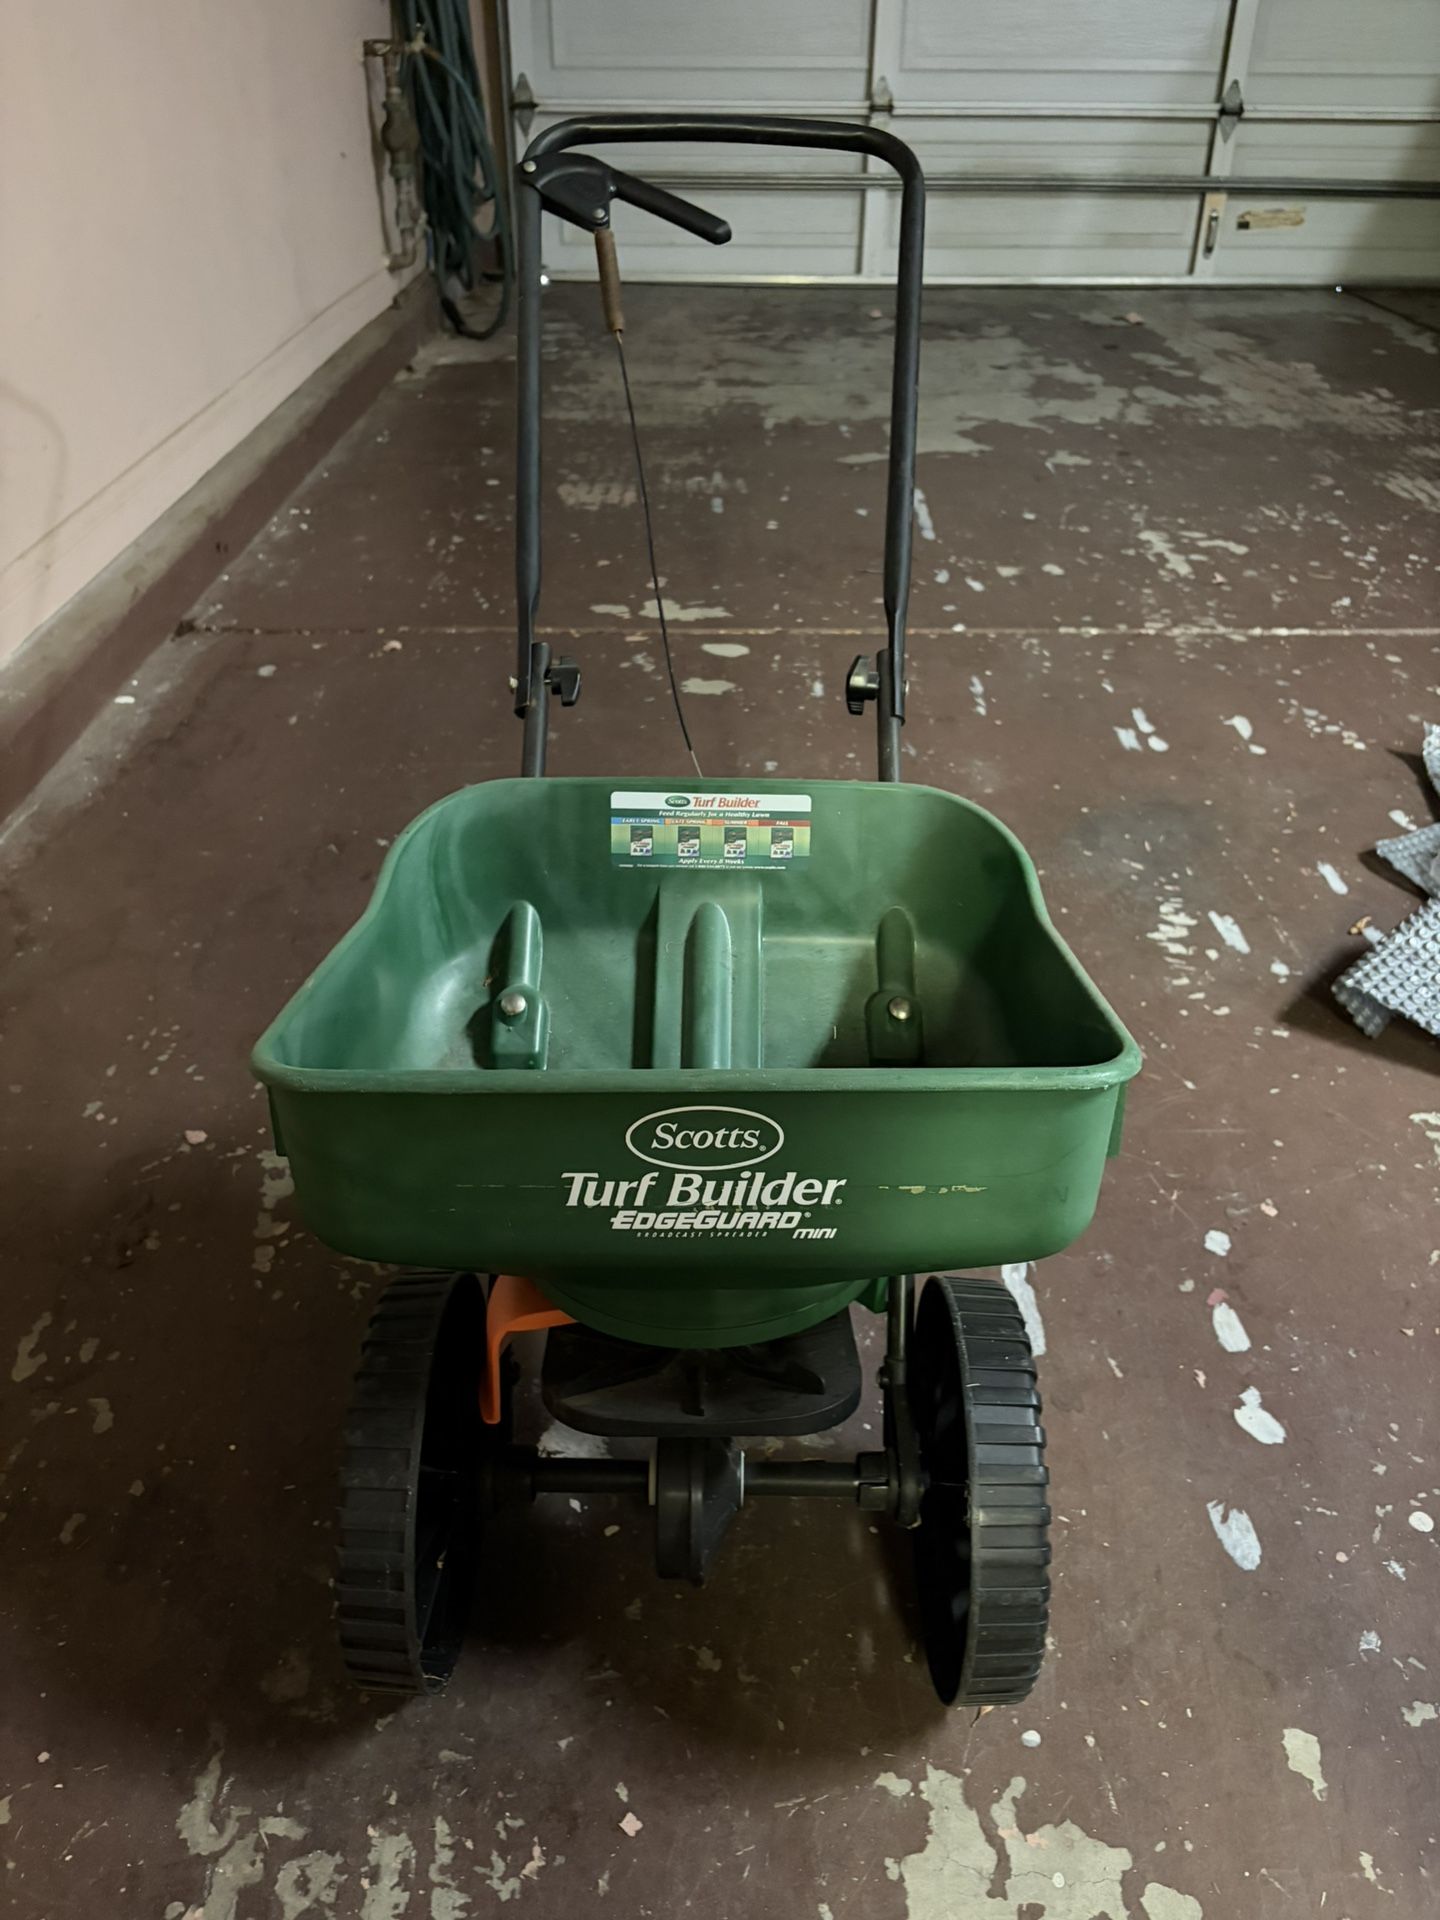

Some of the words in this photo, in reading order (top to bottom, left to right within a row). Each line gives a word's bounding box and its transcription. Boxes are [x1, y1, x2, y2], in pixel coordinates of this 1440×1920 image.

[693, 796, 715, 808] Turf
[718, 797, 760, 808] Builder
[651, 1122, 760, 1149] Scotts
[561, 1172, 660, 1207] Turf
[665, 1170, 848, 1207] Builder
